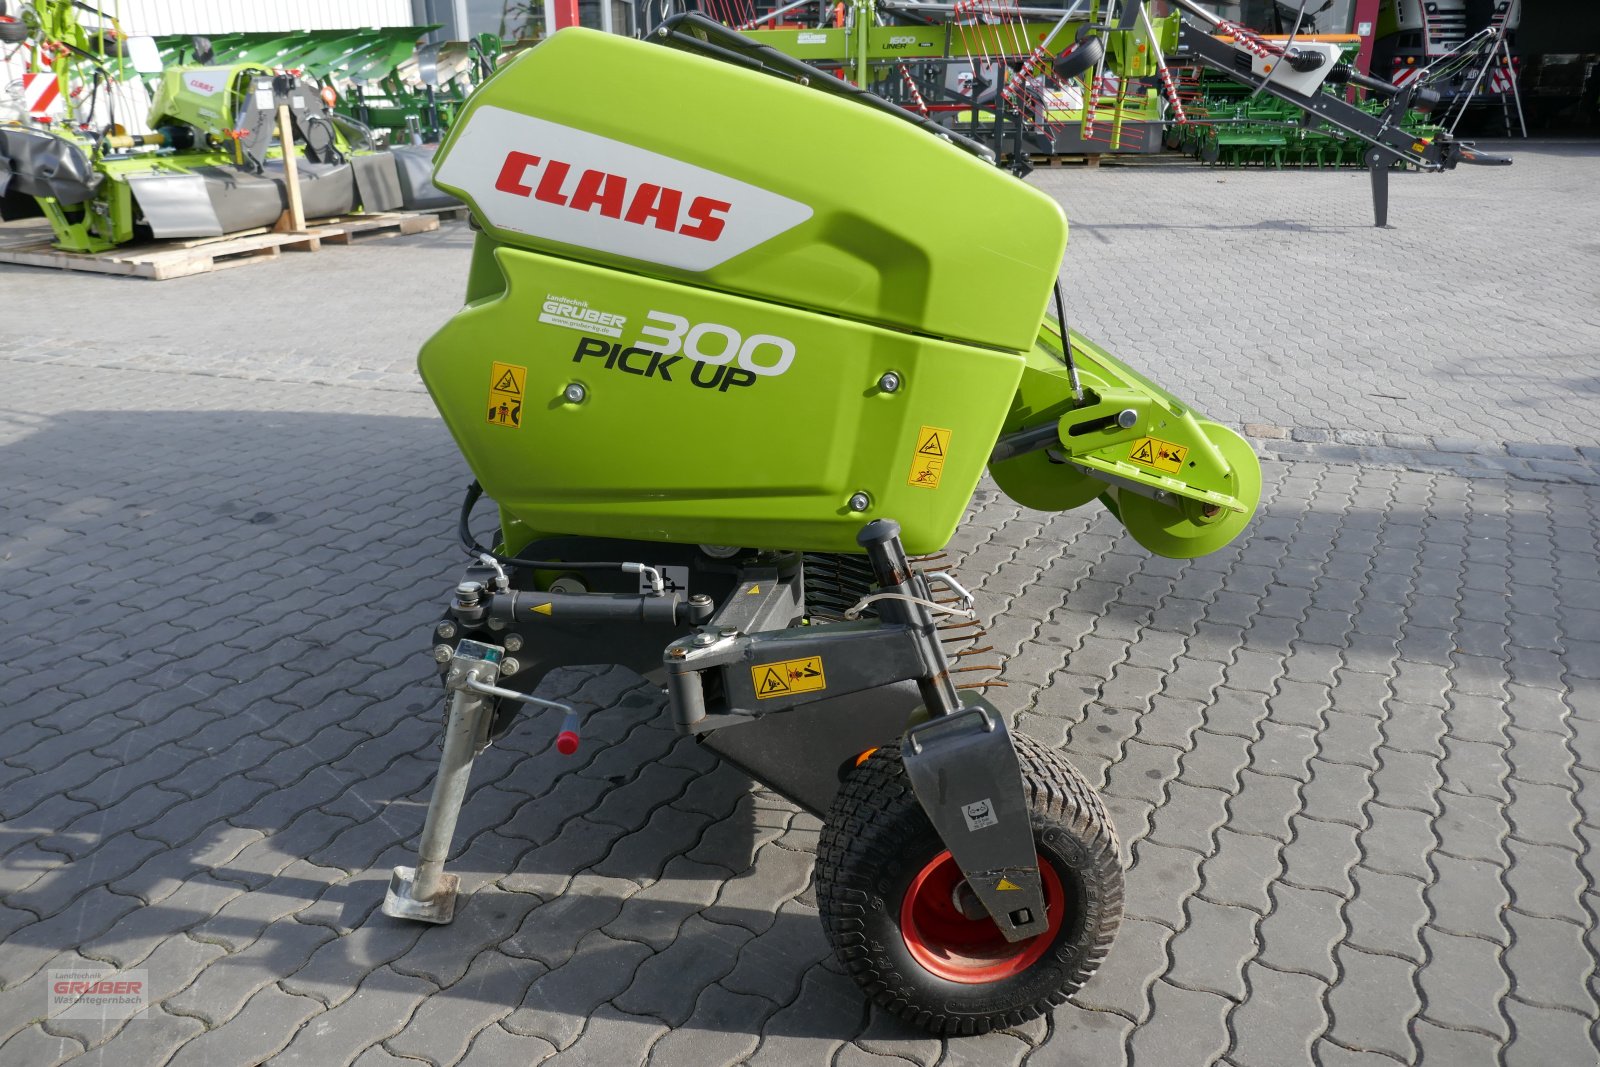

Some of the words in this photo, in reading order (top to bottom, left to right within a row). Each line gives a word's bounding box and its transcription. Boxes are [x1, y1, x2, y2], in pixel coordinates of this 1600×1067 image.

[495, 151, 732, 242] CLAAS
[542, 300, 627, 328] GRUBER
[546, 293, 589, 308] Landtechnik
[551, 317, 610, 334] www.gruber-kg.de
[572, 337, 684, 382] PICK
[690, 361, 757, 393] UP
[634, 310, 796, 377] 300
[1077, 870, 1099, 946] KENDA
